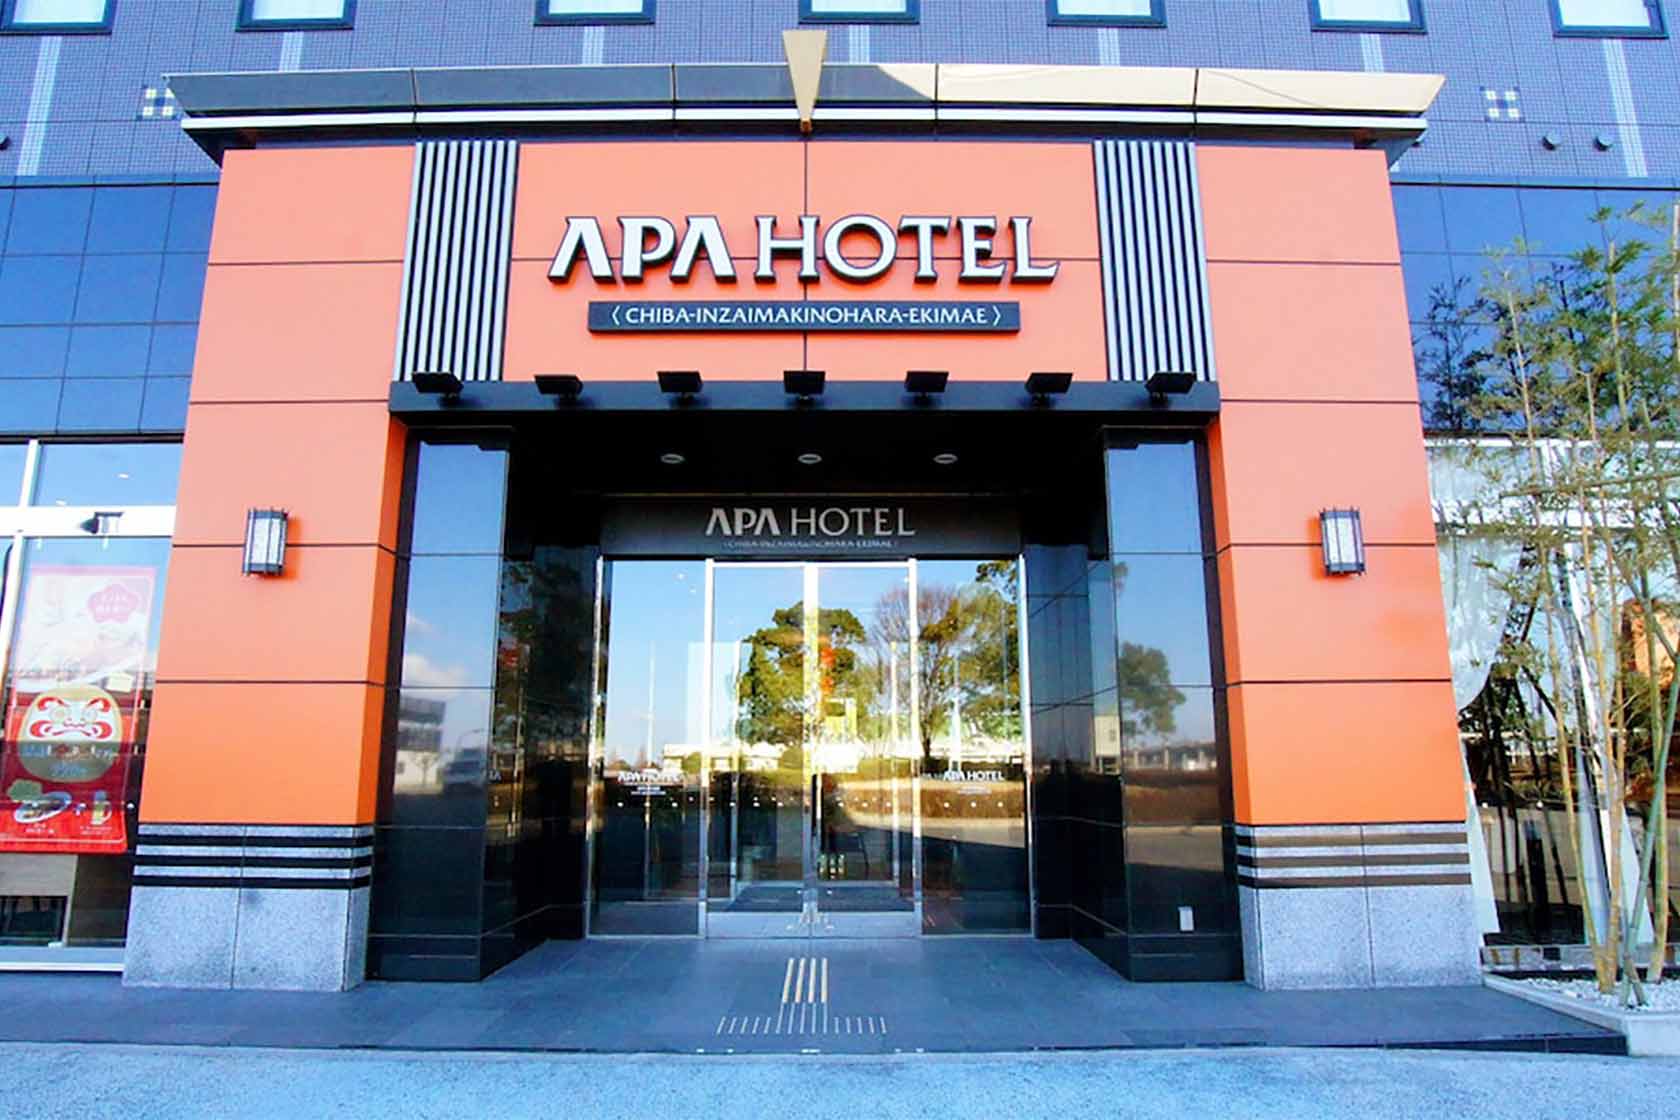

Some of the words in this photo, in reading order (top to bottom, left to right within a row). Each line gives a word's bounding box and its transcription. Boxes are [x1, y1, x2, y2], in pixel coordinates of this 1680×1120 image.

[547, 215, 737, 283] APA
[753, 214, 1060, 284] HOTEL
[705, 507, 781, 536] APA
[790, 507, 916, 536] HOTEL
[966, 769, 1005, 781] HOTEL
